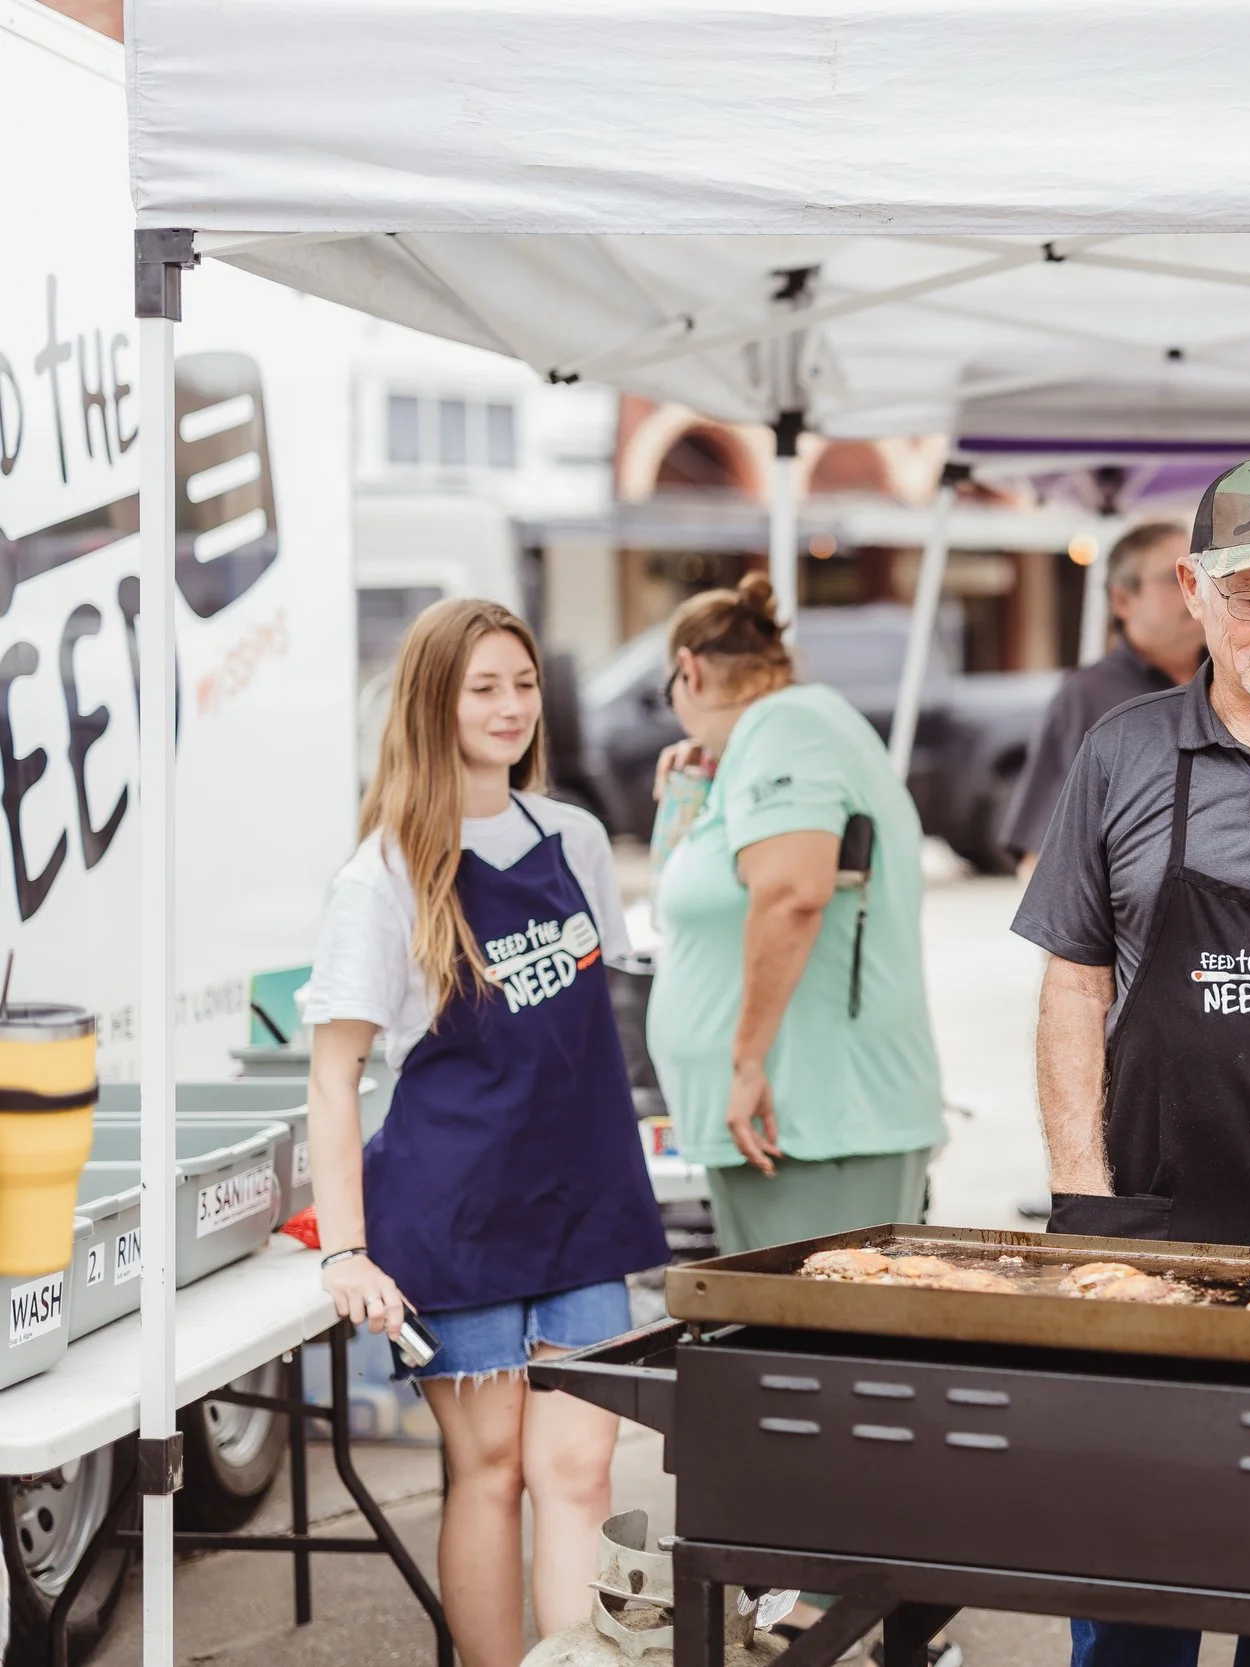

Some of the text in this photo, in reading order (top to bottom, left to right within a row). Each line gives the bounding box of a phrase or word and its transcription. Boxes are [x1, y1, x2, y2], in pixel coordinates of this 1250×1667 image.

[485, 932, 528, 963] FEED
[1200, 951, 1235, 970] FEED
[503, 950, 577, 1014] NEED
[88, 1231, 141, 1284] 2. RIN
[12, 1281, 63, 1333] WASH
